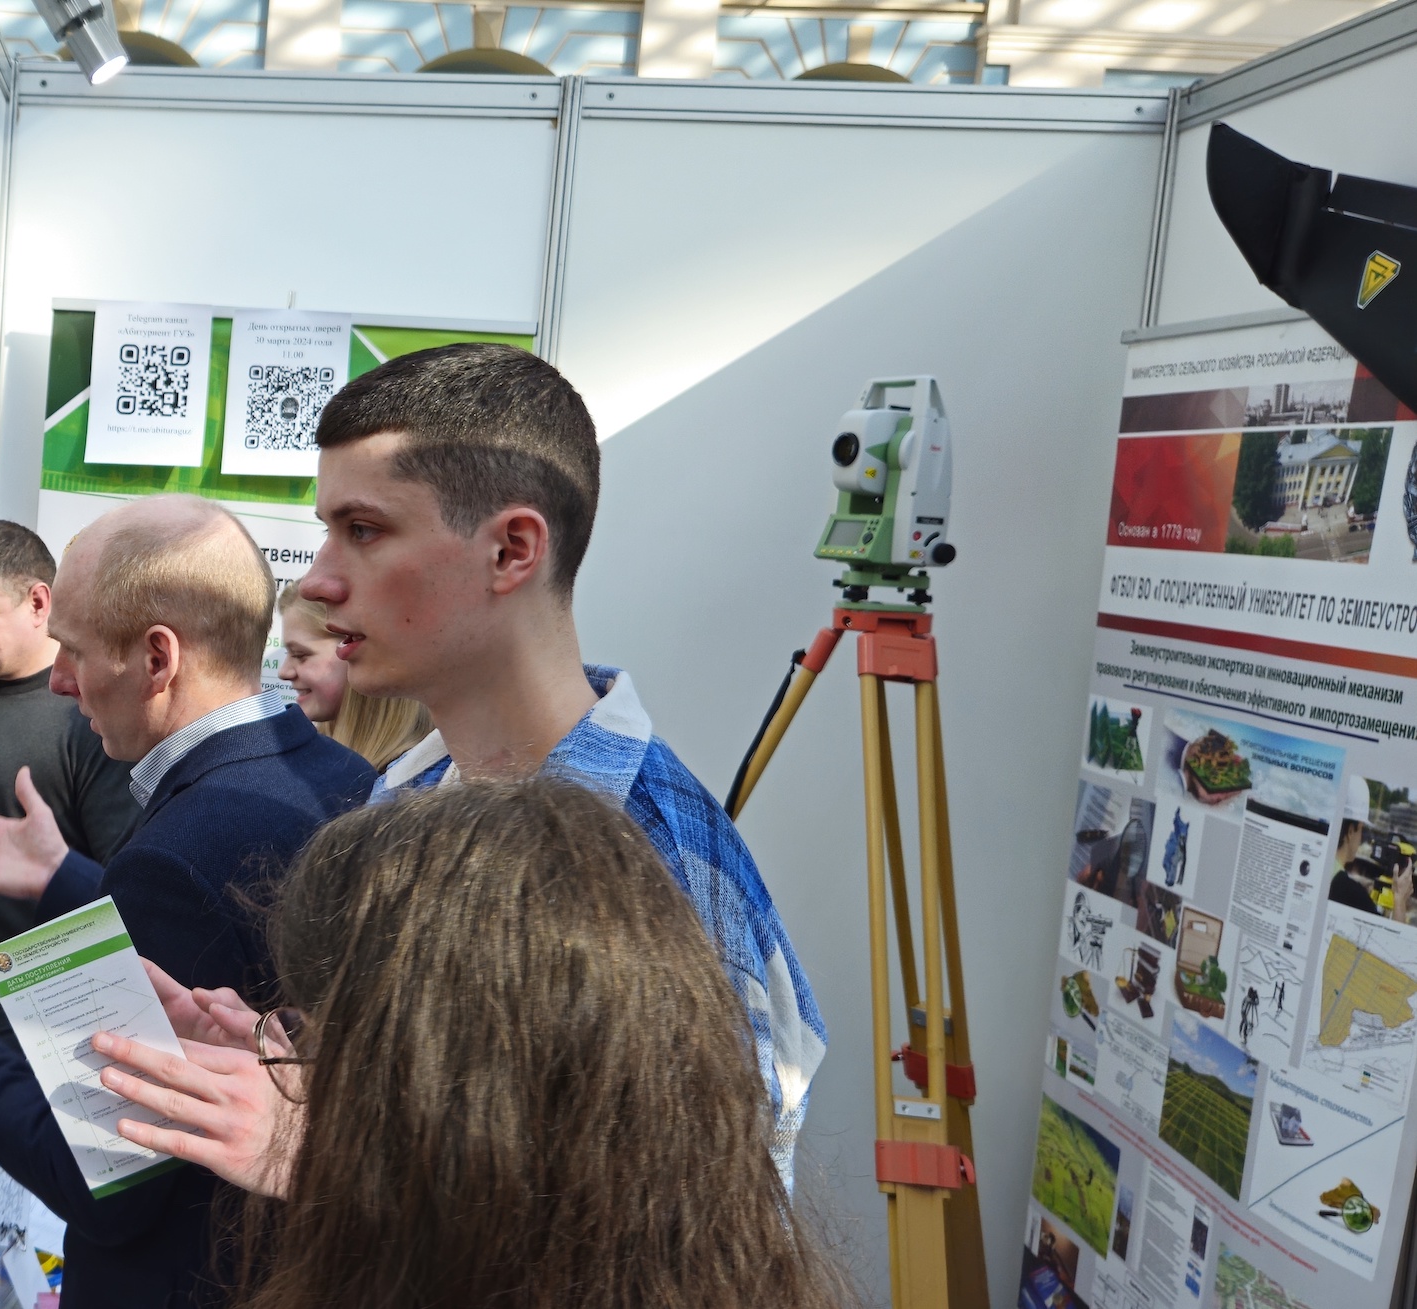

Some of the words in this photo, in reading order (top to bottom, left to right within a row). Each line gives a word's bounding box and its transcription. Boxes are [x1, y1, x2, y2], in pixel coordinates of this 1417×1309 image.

[127, 314, 163, 325] Telegram
[165, 317, 188, 325] канал
[248, 323, 271, 332] День
[272, 325, 310, 334] открытых
[313, 324, 342, 334] дверей
[117, 327, 172, 339] «Абитуриент
[255, 336, 265, 344] 30
[267, 338, 290, 347] марта
[293, 337, 312, 345] 2024
[314, 339, 333, 347] года
[282, 350, 304, 359] 11.00
[1118, 522, 1150, 538] Основан
[1152, 528, 1158, 538] в
[1161, 524, 1182, 540] 1779
[1183, 528, 1202, 544] году
[1110, 574, 1137, 597] ФГБОУ
[1137, 577, 1151, 600] ВО
[1154, 580, 1247, 611] «ГОСУДАРСТВЕННЫЙ
[1248, 587, 1316, 621] УНИВЕРСИТЕТ
[1317, 596, 1336, 623] ПО
[1130, 639, 1207, 666] Землеустроительная
[1207, 656, 1254, 677] экспертиза
[1255, 664, 1267, 679] как
[1267, 666, 1347, 695] инновационный
[1347, 682, 1404, 705] механизм
[1194, 677, 1247, 701] обеспечения
[1247, 688, 1306, 717] эффективного
[1309, 705, 1417, 740] импортозамещени
[6, 976, 24, 988] ДАТЫ
[24, 956, 72, 979] ПОСТУПЛЕНИЯ
[1320, 1098, 1373, 1127] стоимость
